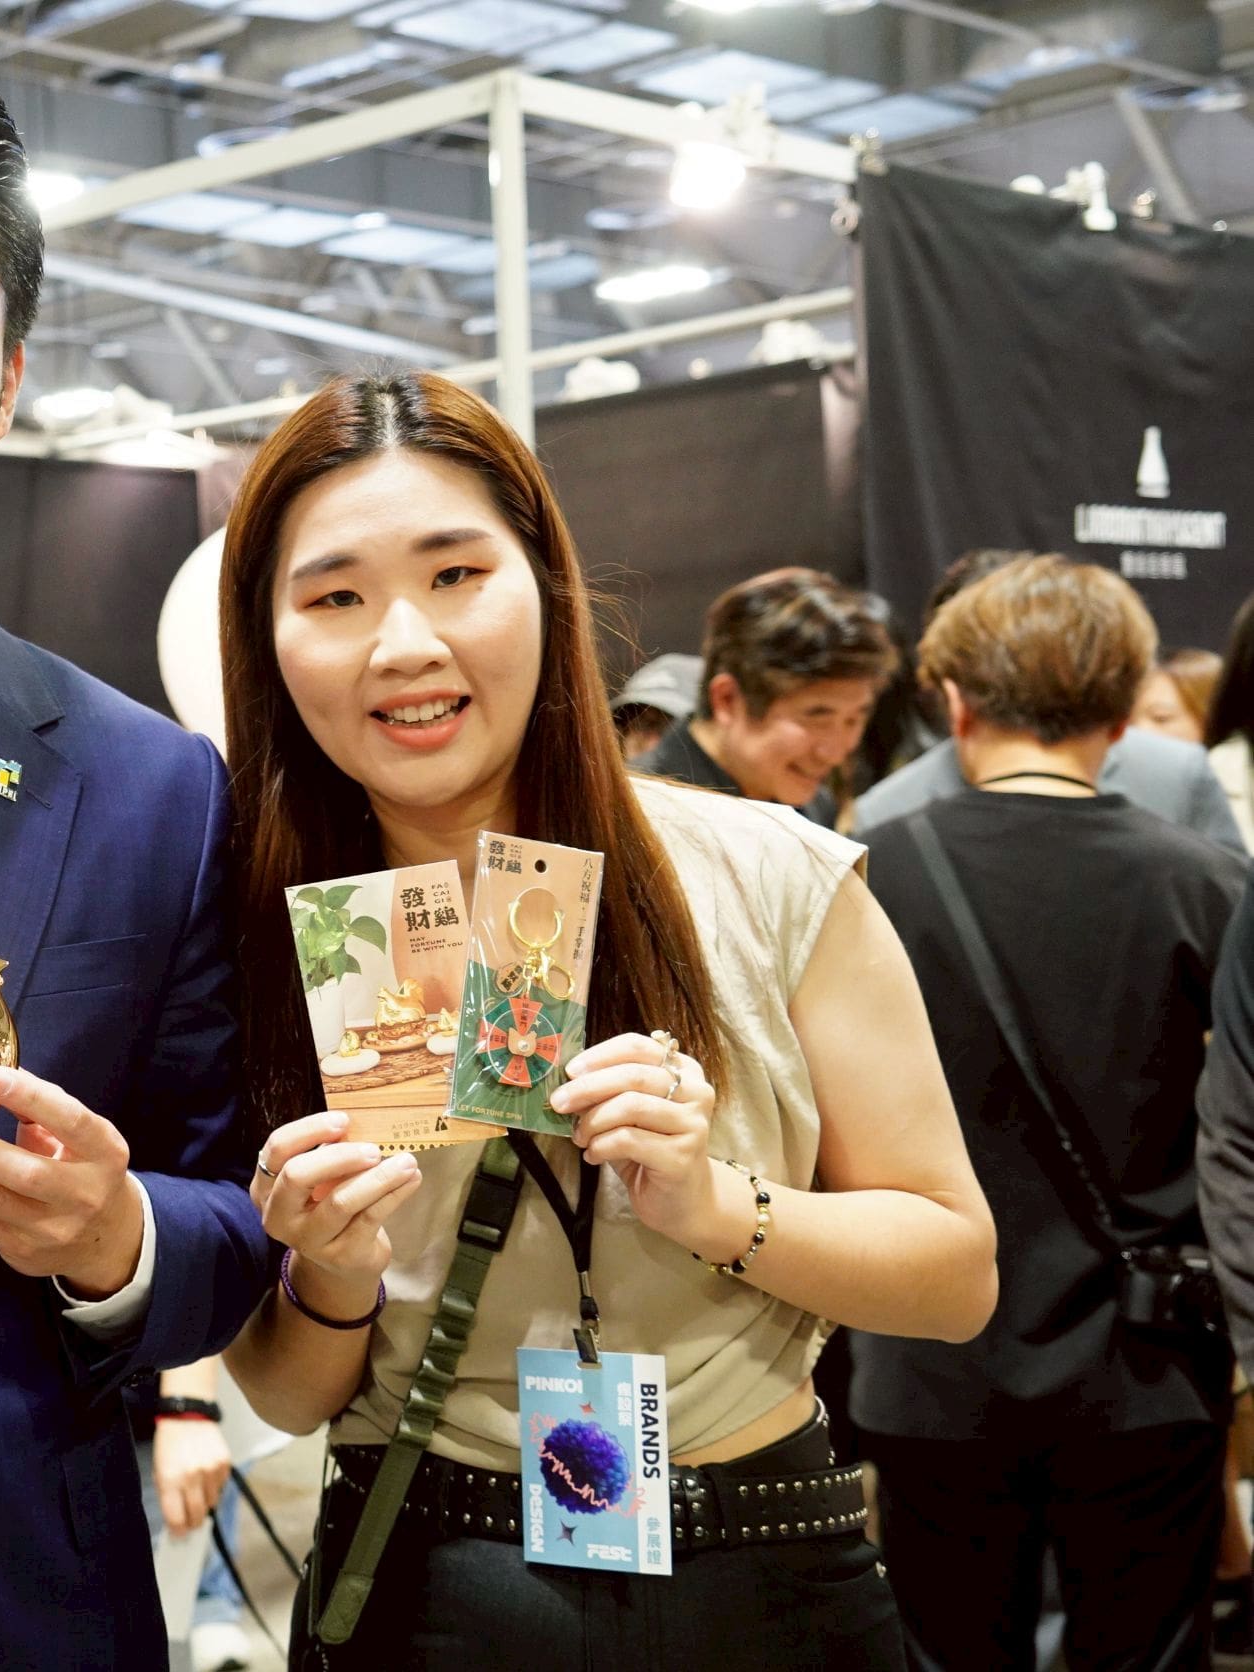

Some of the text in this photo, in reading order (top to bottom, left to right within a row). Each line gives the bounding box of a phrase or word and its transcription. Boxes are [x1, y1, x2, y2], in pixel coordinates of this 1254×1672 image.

[410, 938, 447, 949] FORTUNE
[422, 944, 445, 952] WITH
[471, 1106, 505, 1118] FORTUNE
[505, 1112, 523, 1121] SPIN
[525, 1375, 583, 1394] PINKOI
[640, 1383, 661, 1480] BRANDS
